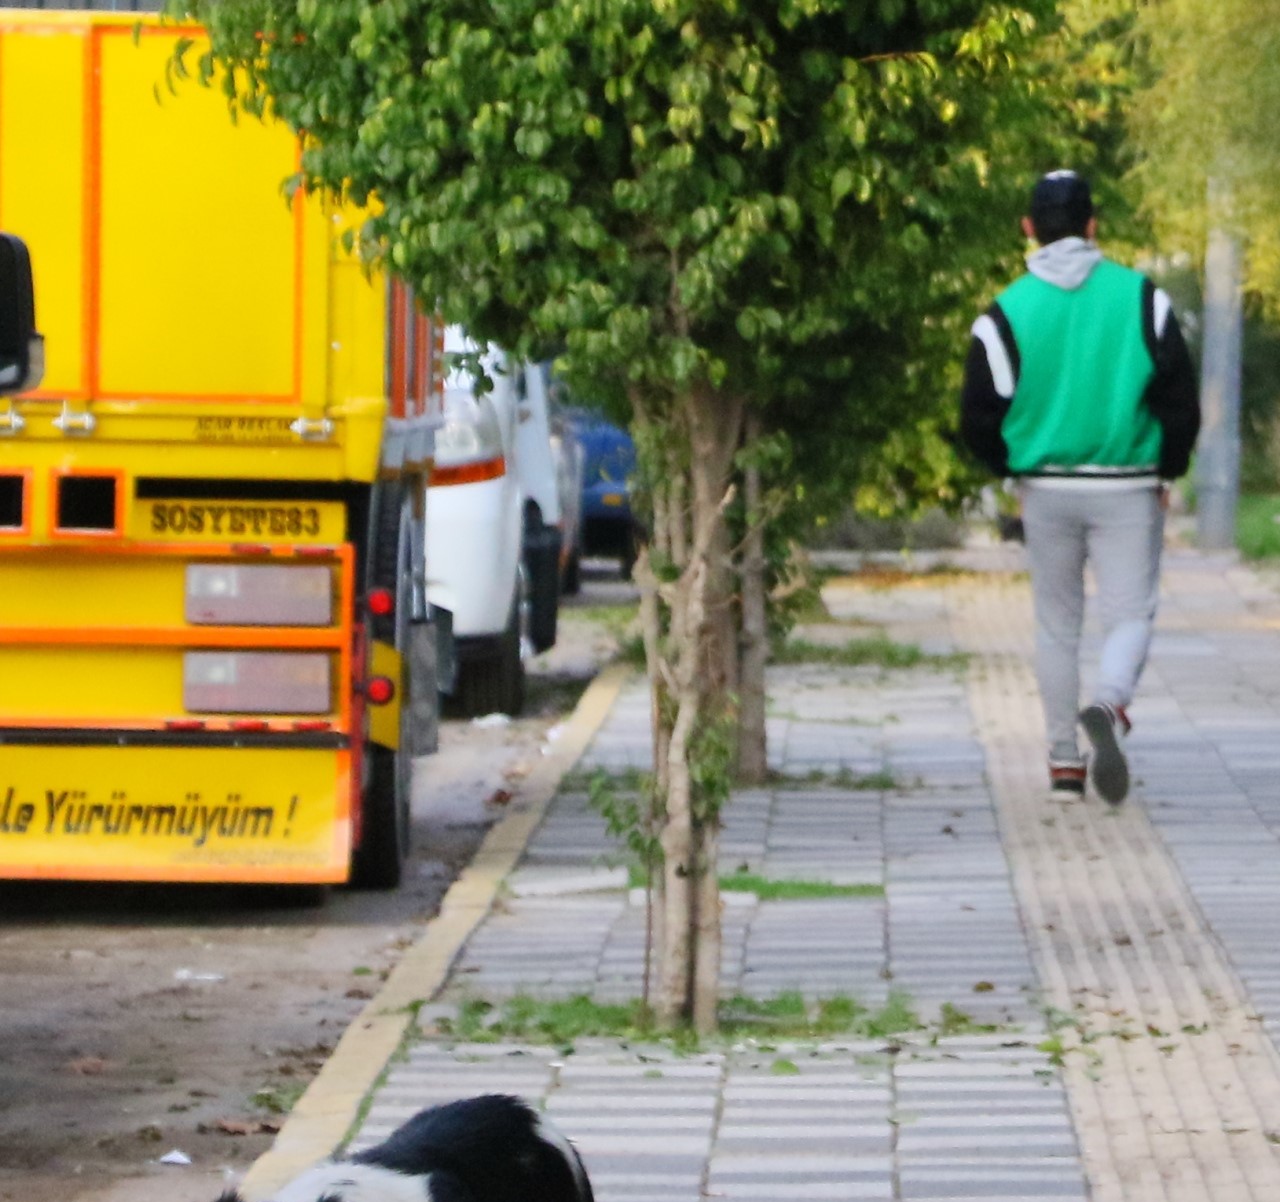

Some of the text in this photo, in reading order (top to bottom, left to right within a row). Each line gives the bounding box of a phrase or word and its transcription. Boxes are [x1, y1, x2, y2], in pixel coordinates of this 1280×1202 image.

[152, 504, 320, 535] SOSYETE83
[0, 787, 34, 833] le
[45, 790, 275, 847] Yürürmüyüm
